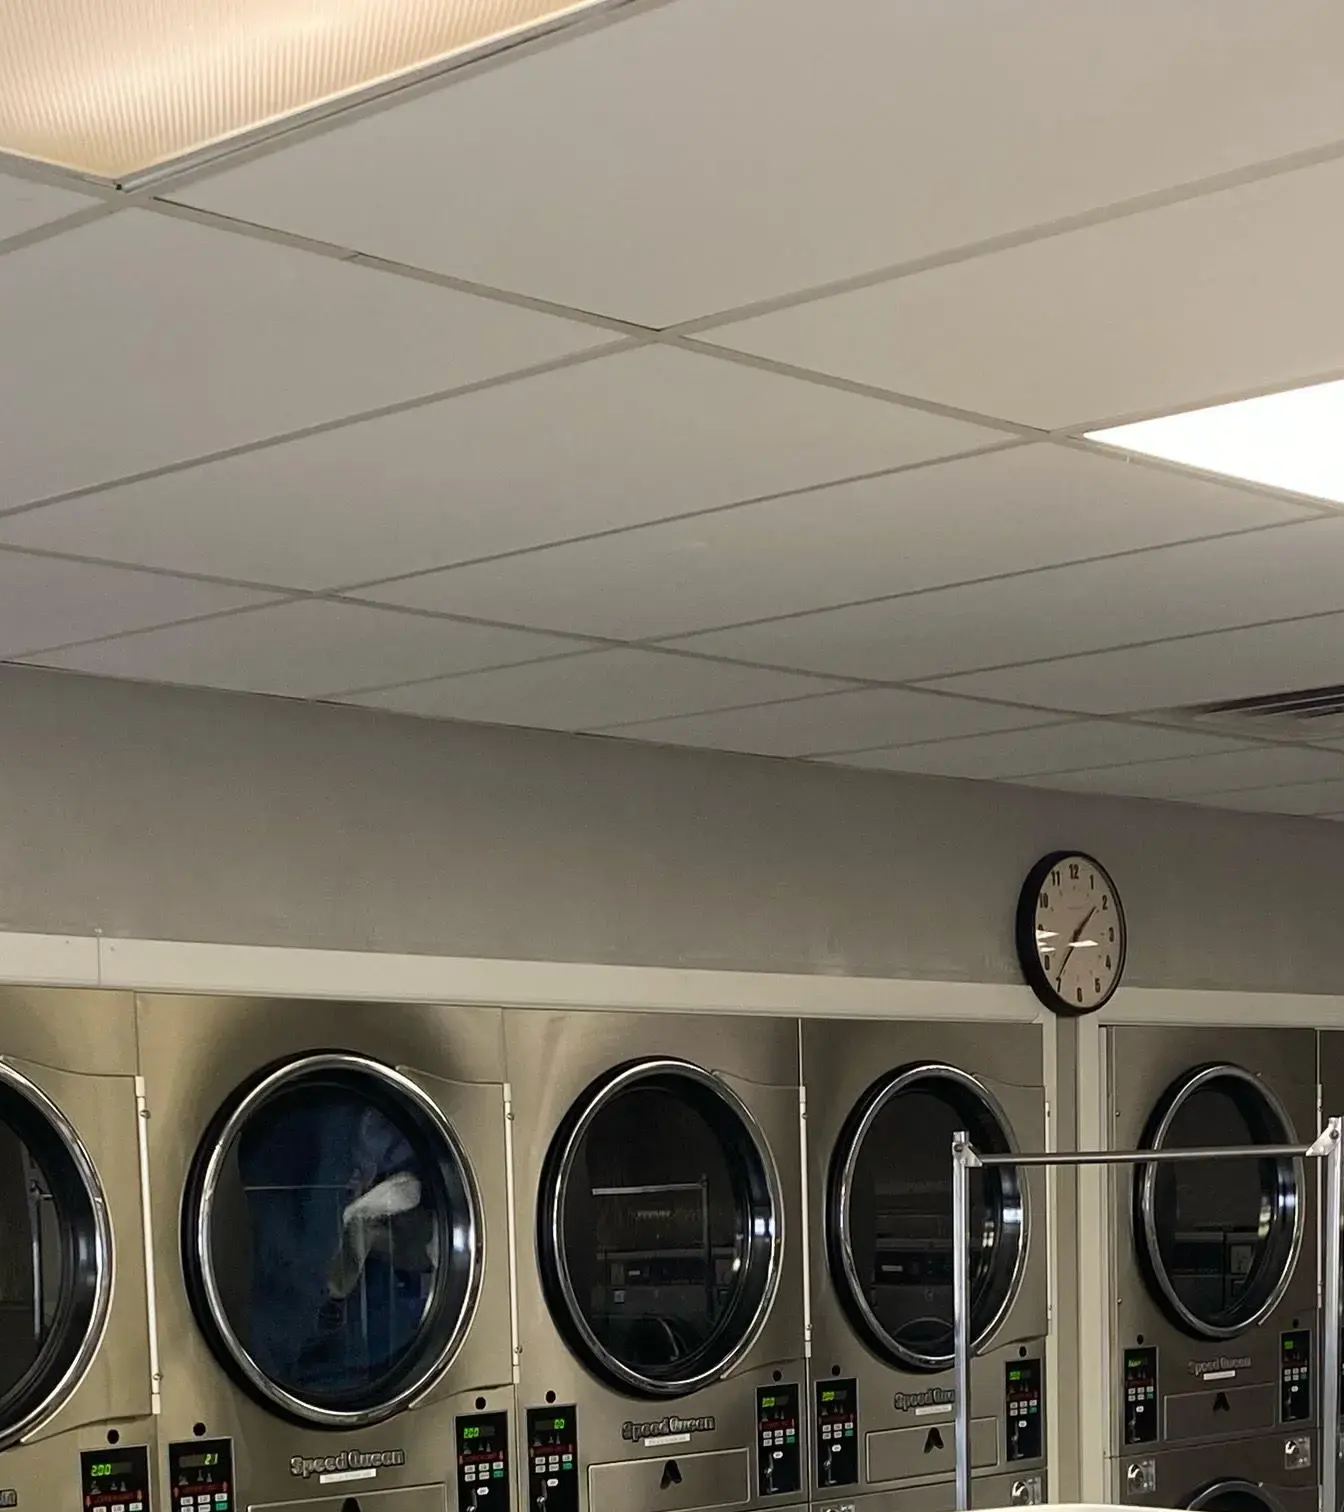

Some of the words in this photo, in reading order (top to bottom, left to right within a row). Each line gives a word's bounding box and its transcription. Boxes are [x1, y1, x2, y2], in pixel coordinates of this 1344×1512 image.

[1051, 871, 1060, 886] 11
[1069, 864, 1079, 879] 12
[290, 1450, 348, 1478] Speed
[348, 1448, 405, 1468] Queen
